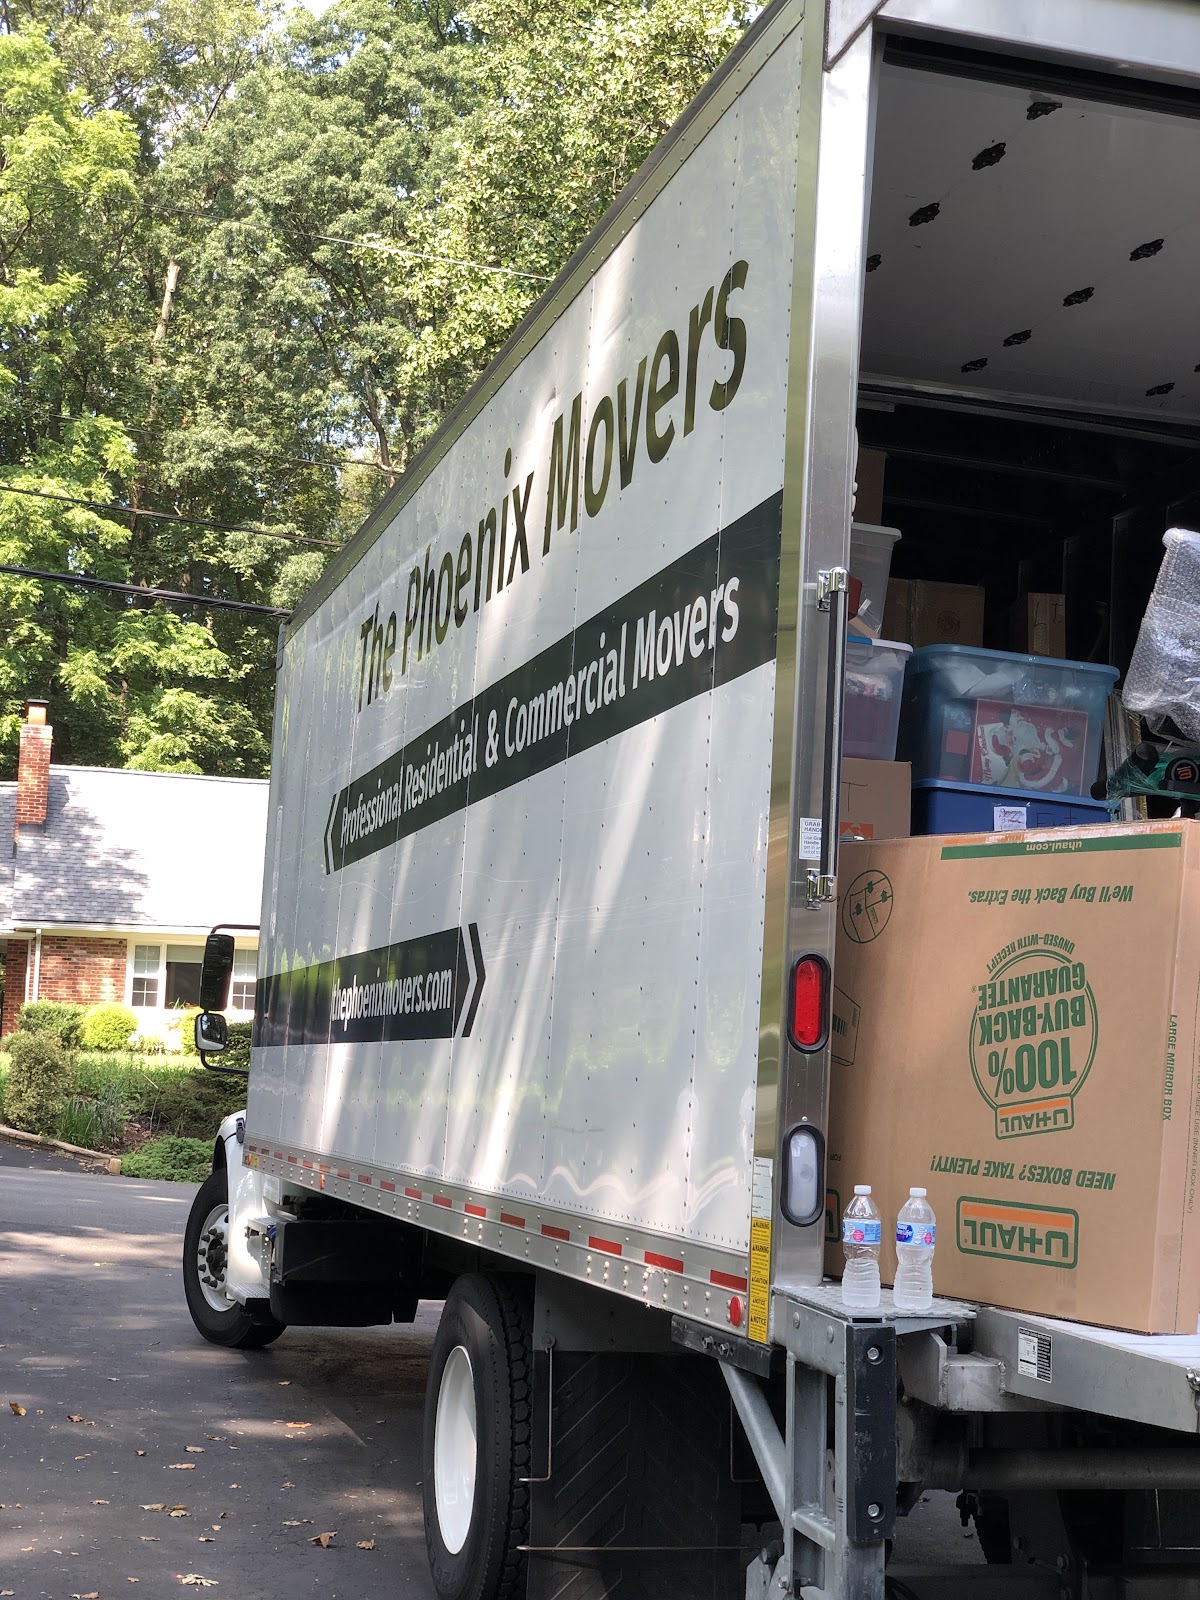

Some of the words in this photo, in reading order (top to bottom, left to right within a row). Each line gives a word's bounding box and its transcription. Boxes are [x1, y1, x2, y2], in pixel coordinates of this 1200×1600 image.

[358, 600, 397, 714] The
[401, 447, 535, 676] Phoenix
[542, 259, 749, 557] Movers
[340, 765, 404, 849] Professional
[404, 713, 479, 813] Residential
[485, 709, 500, 768] &
[504, 621, 627, 758] Commercial
[632, 576, 740, 690] Movers
[1026, 840, 1083, 852] uhaul.com
[967, 889, 1008, 905] Extras.
[1011, 888, 1032, 905] the
[1034, 887, 1068, 904] Back
[1070, 884, 1097, 903] Buy
[1098, 885, 1134, 902] We'll
[986, 941, 1017, 974] RECEIPT
[978, 962, 1086, 1011] GUARANTEE
[331, 966, 453, 1031] thephoenixmovers.com
[979, 995, 1086, 1046] BUY-BACK
[1167, 1014, 1178, 1050] LARGE
[988, 1037, 1077, 1098] 100%
[1164, 1052, 1175, 1096] MIRROR
[1162, 1098, 1172, 1121] BOX
[829, 1154, 842, 1162] FOR
[1191, 1137, 1199, 1167] (INNER
[930, 1155, 981, 1176] PLENTY!
[982, 1160, 1016, 1180] TAKE
[1018, 1164, 1073, 1186] BOXES?
[1075, 1169, 1117, 1191] NEED
[1187, 1188, 1195, 1214] ONLY)
[755, 1221, 770, 1230] WARNING
[755, 1244, 770, 1254] WARNING
[754, 1276, 768, 1285] CAUTION
[753, 1316, 767, 1326] NOTICE
